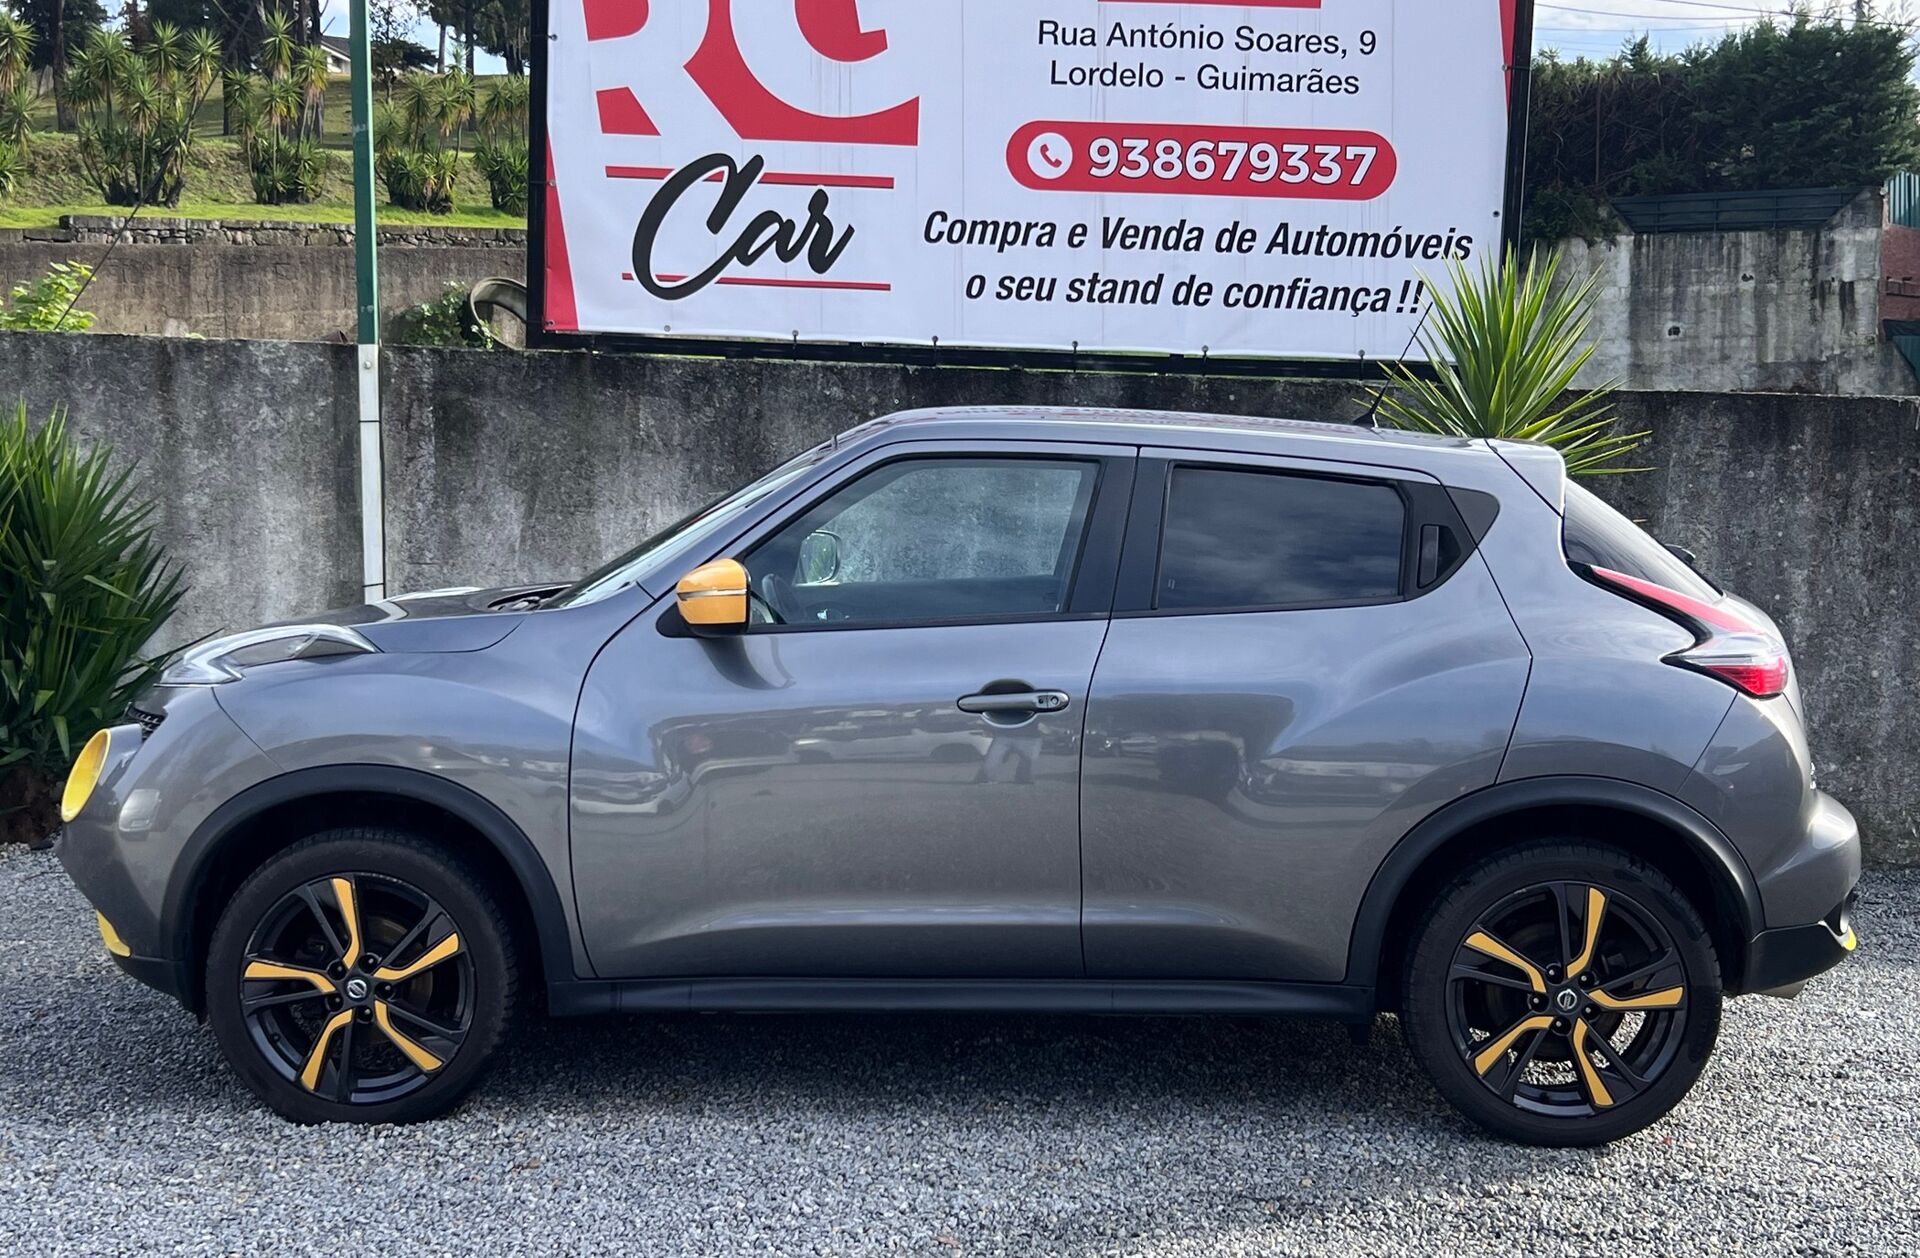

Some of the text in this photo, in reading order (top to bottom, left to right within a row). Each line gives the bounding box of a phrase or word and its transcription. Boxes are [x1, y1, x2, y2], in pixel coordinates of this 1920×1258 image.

[1038, 19, 1377, 60] Rua António Soares, 9
[1050, 59, 1164, 89] Lordelo
[1197, 63, 1361, 95] Guimarães
[1088, 137, 1378, 187] 938679337
[632, 153, 855, 301] Car
[924, 210, 1474, 262] Compra e Venda de Automóveis
[965, 274, 986, 301] o
[995, 275, 1058, 302] seu
[1065, 272, 1166, 305] stand
[1172, 274, 1214, 307] de
